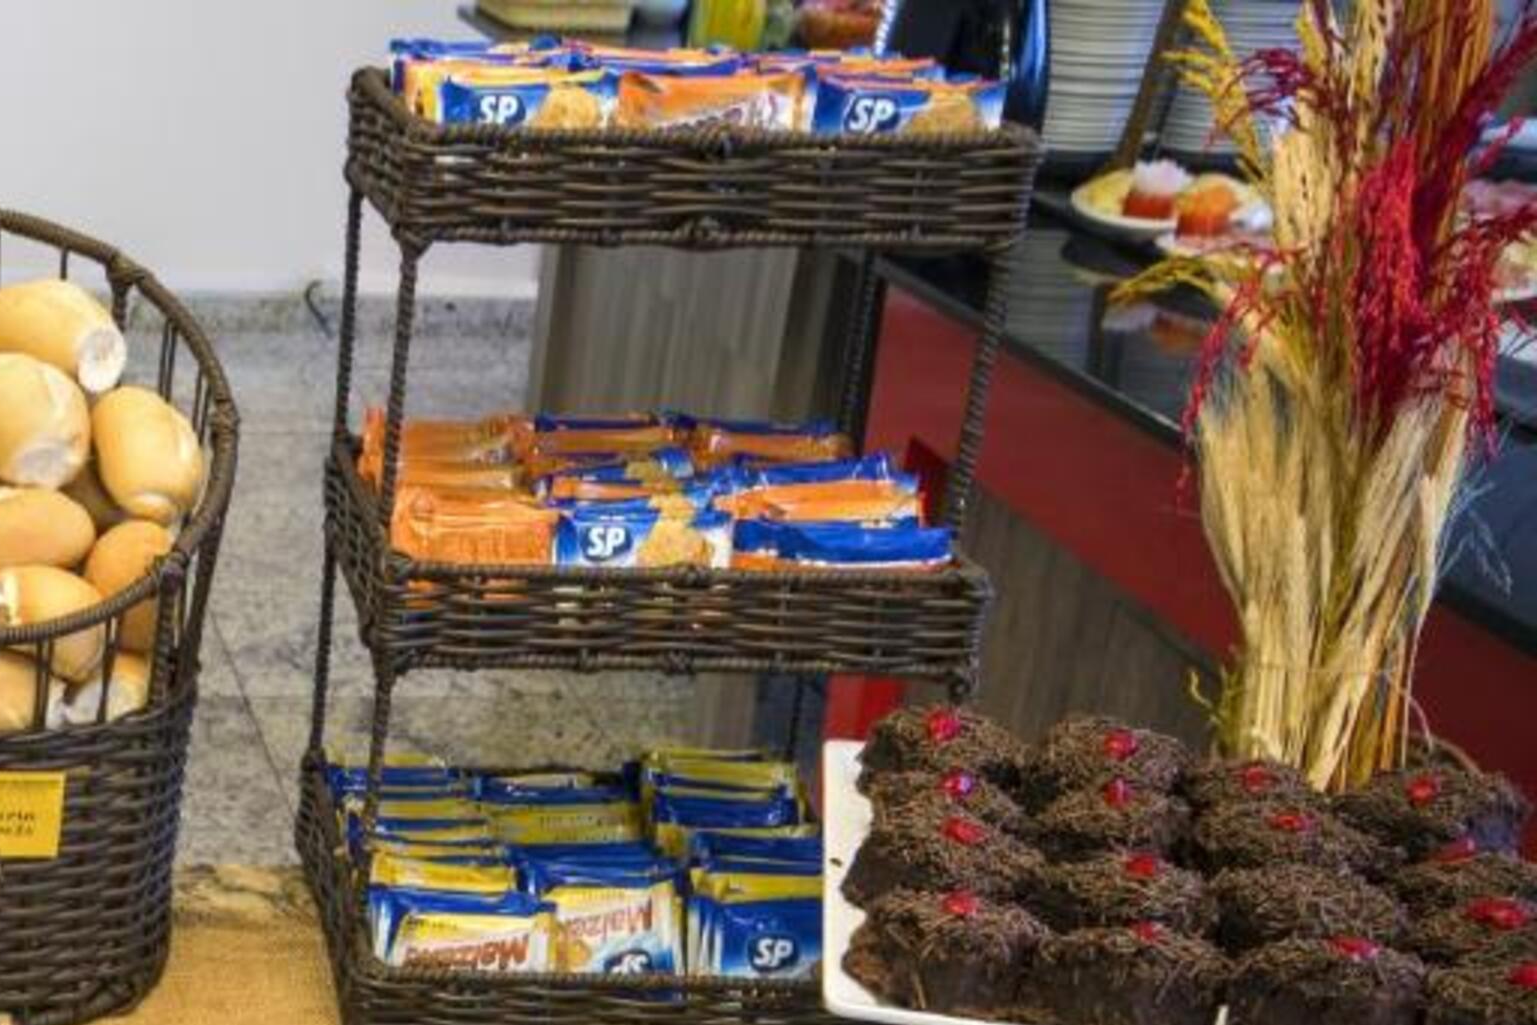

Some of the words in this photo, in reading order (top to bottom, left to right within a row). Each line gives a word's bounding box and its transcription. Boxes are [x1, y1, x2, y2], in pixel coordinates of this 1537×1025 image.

[478, 95, 519, 125] SP
[849, 98, 895, 134] SP
[587, 527, 626, 557] SP
[753, 937, 793, 968] SP
